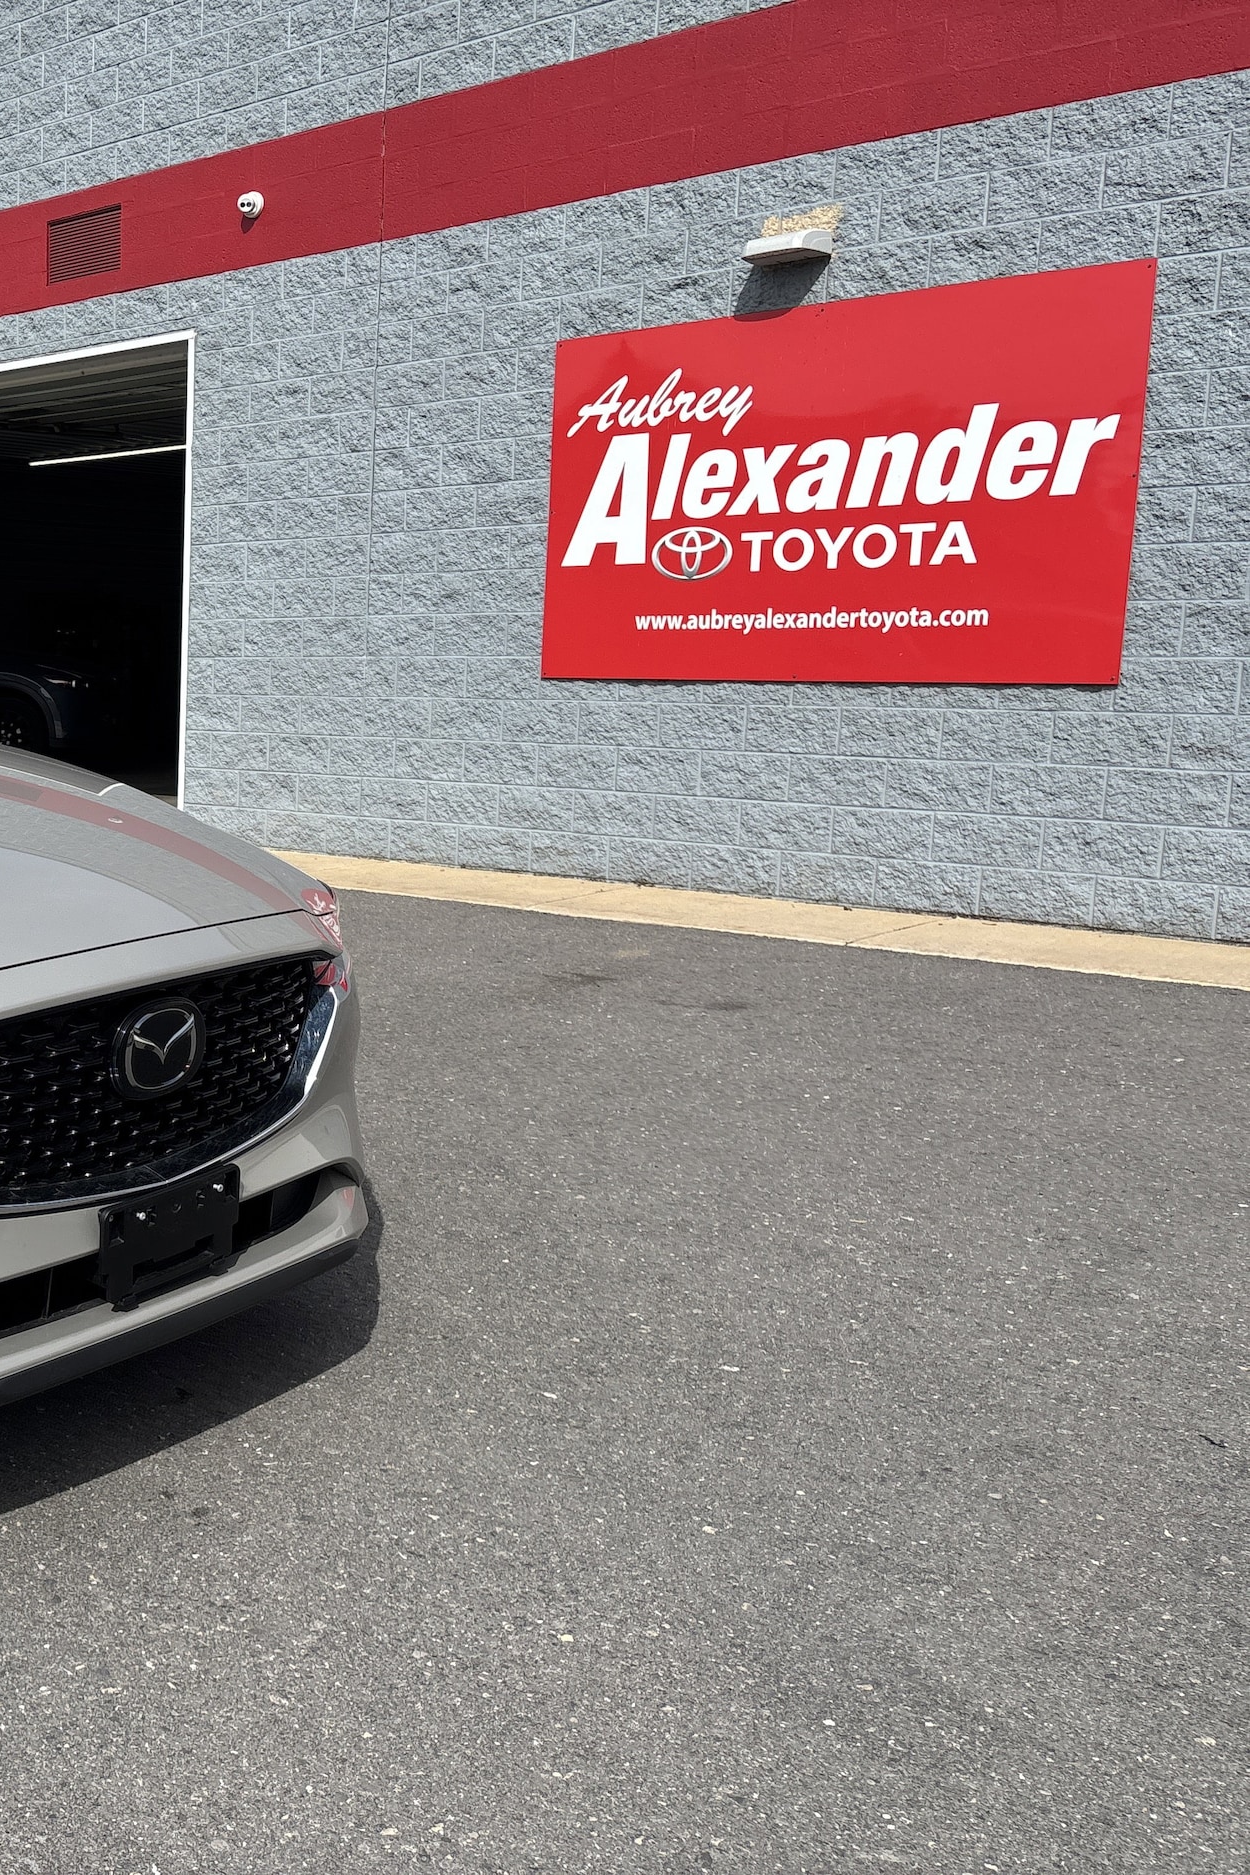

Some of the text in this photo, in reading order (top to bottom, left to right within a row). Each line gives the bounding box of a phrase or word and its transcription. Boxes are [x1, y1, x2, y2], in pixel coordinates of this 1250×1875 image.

[566, 367, 753, 438] Aubrey
[560, 402, 1121, 567] Alexander
[740, 520, 977, 572] TOYOTA
[635, 606, 989, 635] www.aubreyalexandertoyota.com
